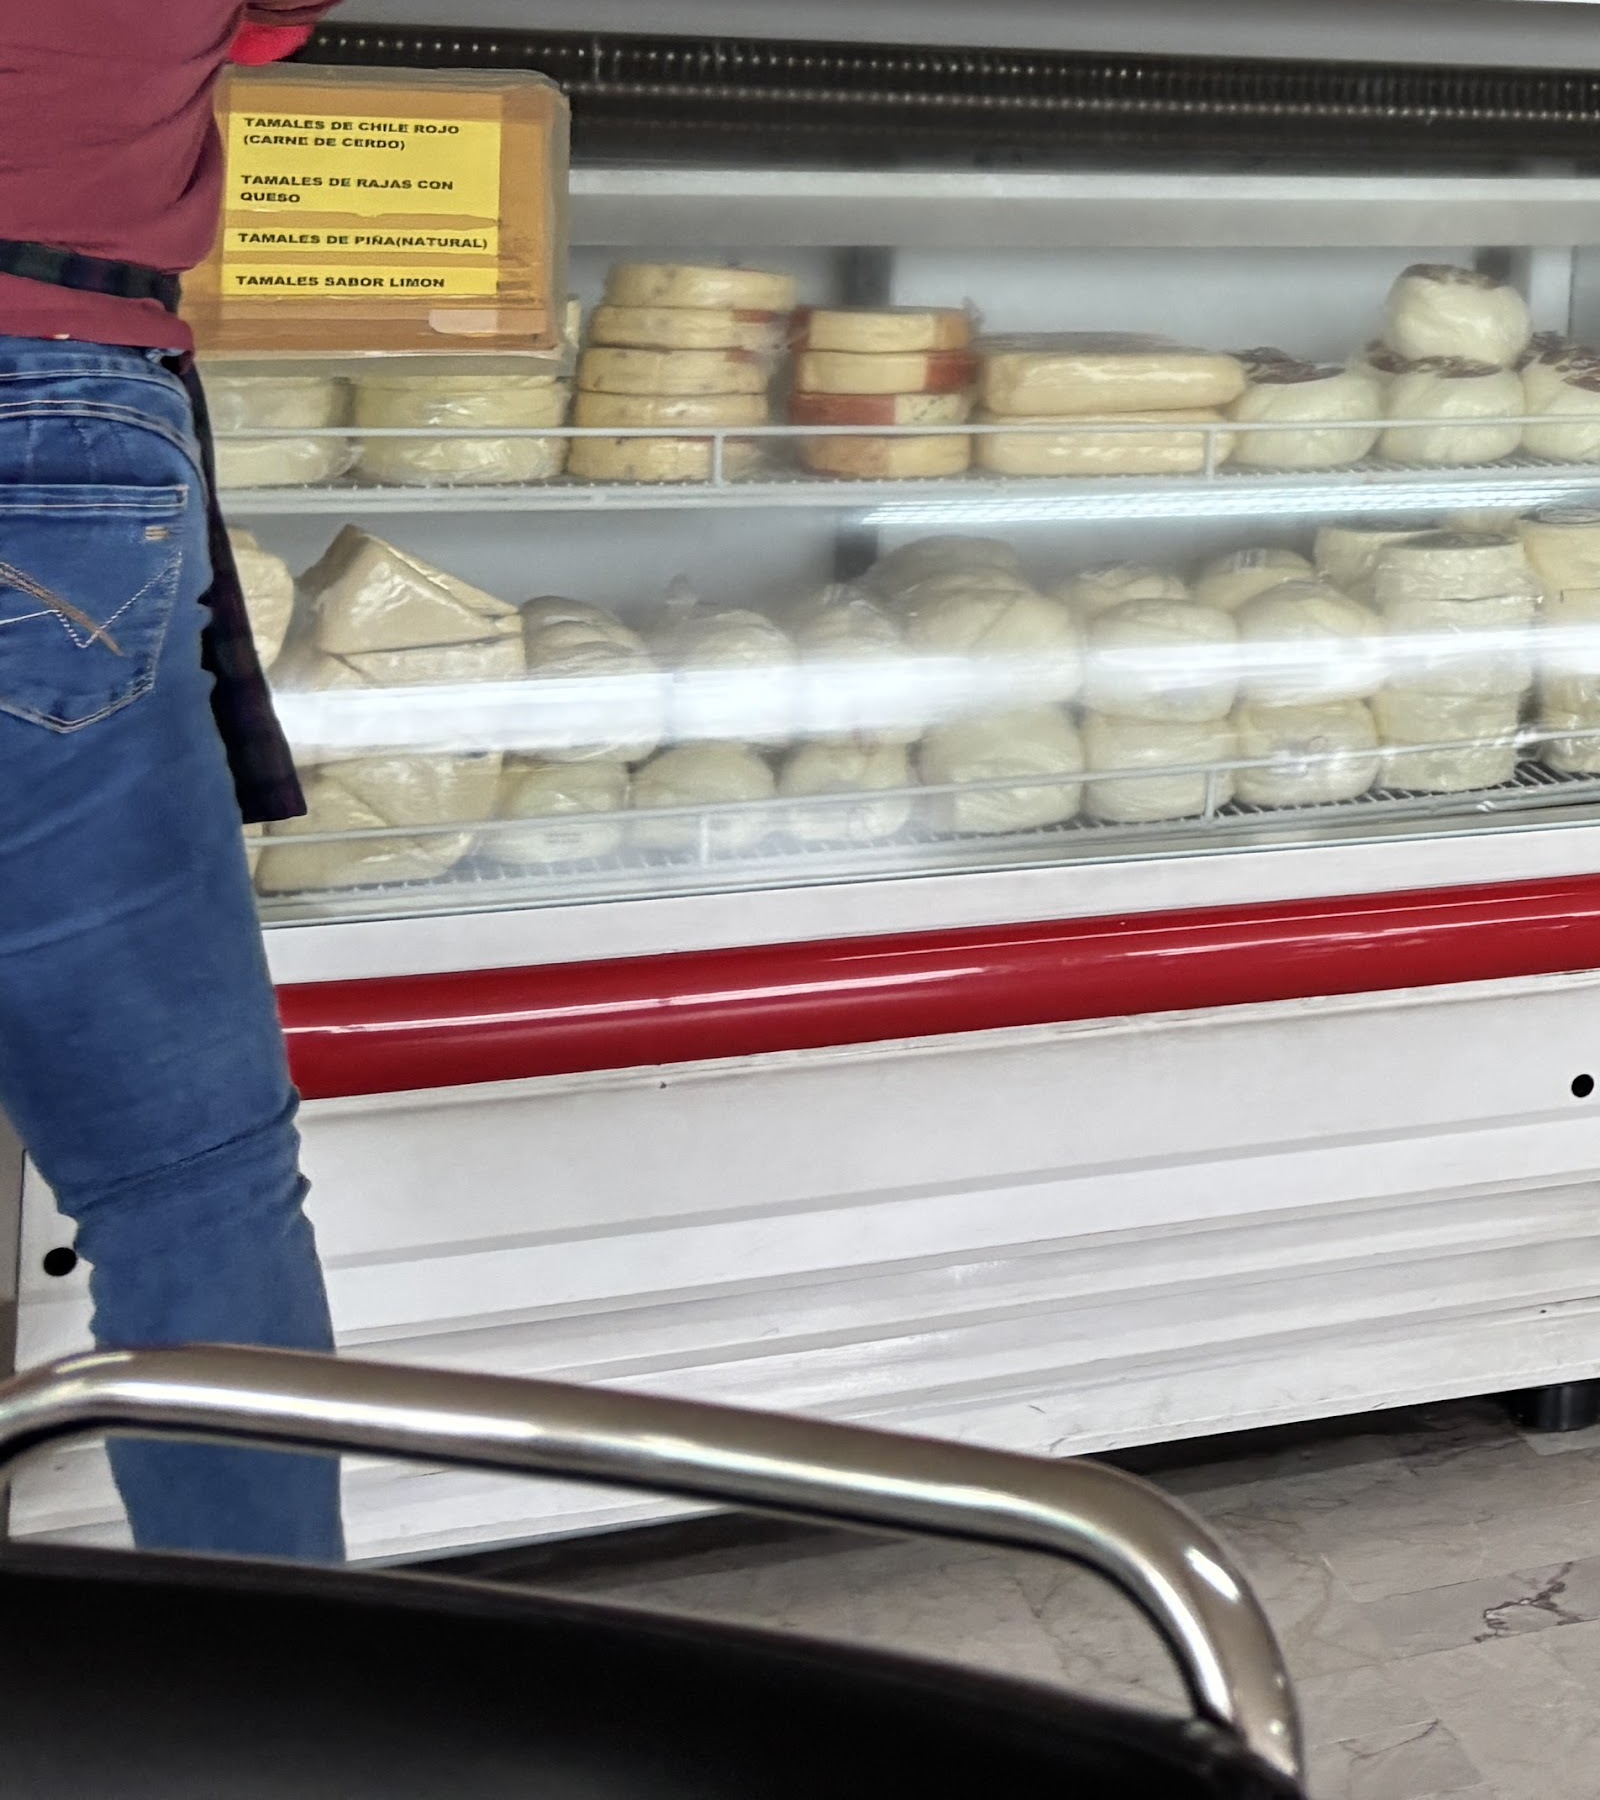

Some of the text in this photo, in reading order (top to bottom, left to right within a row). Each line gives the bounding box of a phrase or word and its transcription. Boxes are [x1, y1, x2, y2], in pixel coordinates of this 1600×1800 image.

[243, 117, 460, 134] TAMALES DE CHILE ROJO
[243, 134, 406, 151] (CARNE DE CERDO)
[240, 175, 454, 190] TAMALES DE RAJAS CON
[240, 192, 301, 203] QUESO
[237, 233, 321, 244] TAMALES
[326, 235, 349, 245] DE
[235, 276, 445, 288] TAMALES SABOR LIMON
